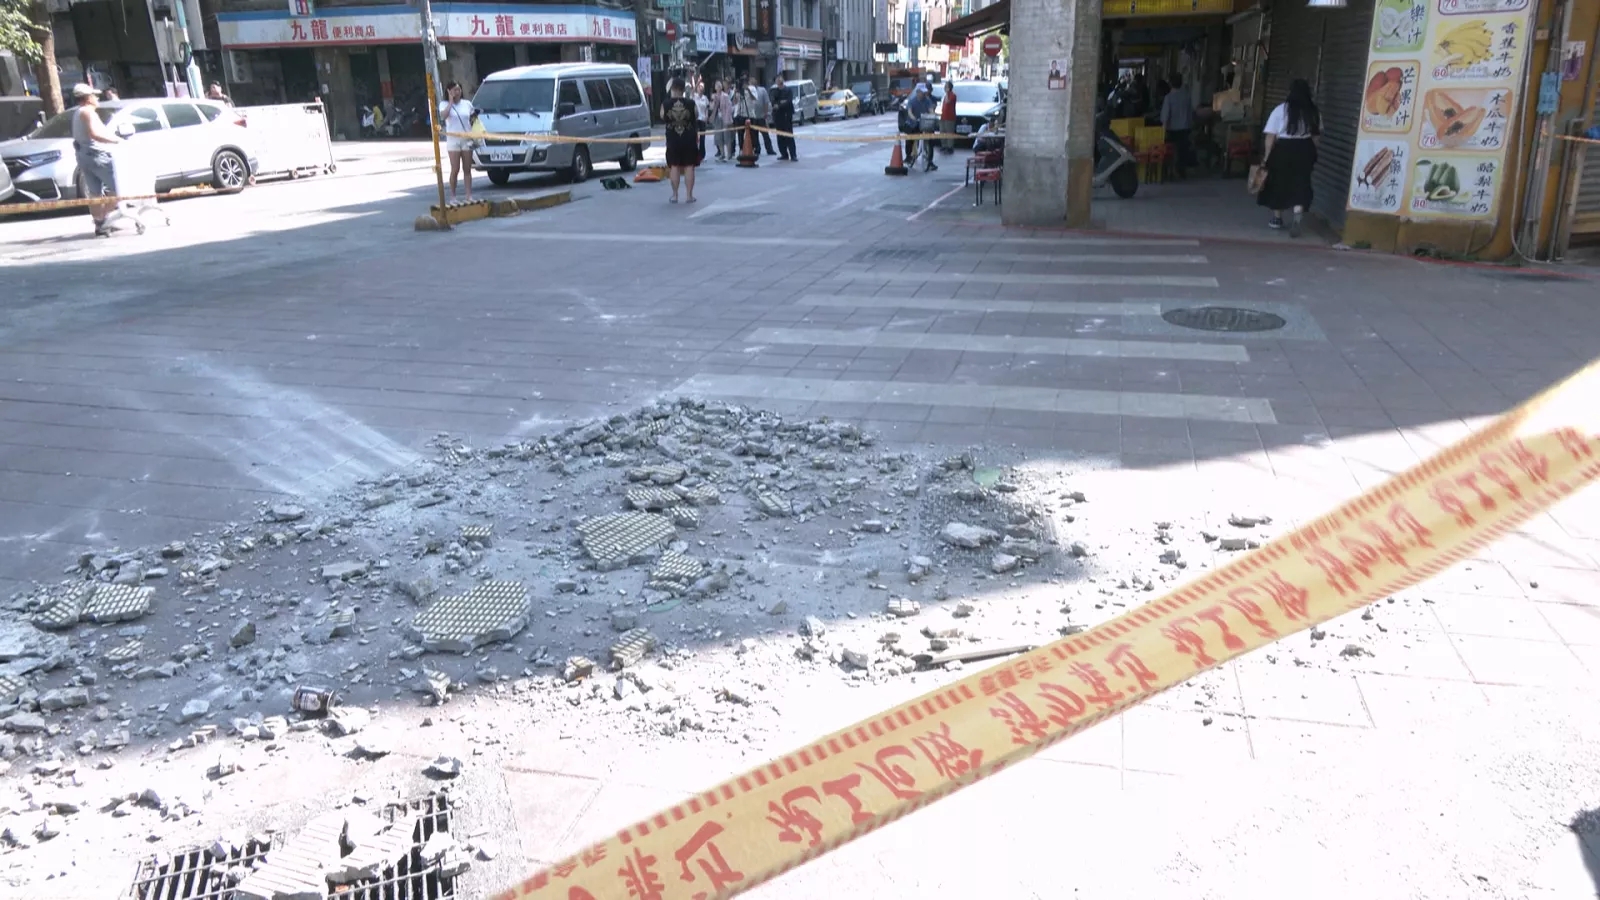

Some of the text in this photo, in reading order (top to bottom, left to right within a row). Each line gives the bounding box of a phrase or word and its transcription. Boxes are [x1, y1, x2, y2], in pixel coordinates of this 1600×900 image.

[1434, 69, 1448, 77] 60
[1492, 22, 1518, 78] 香蕉牛奶
[1395, 66, 1416, 126] 芒果汁
[1480, 93, 1506, 146] 木瓜牛奶
[1423, 136, 1436, 145] 70
[1413, 200, 1426, 208] 80
[1470, 162, 1496, 213] 酪梨牛奶
